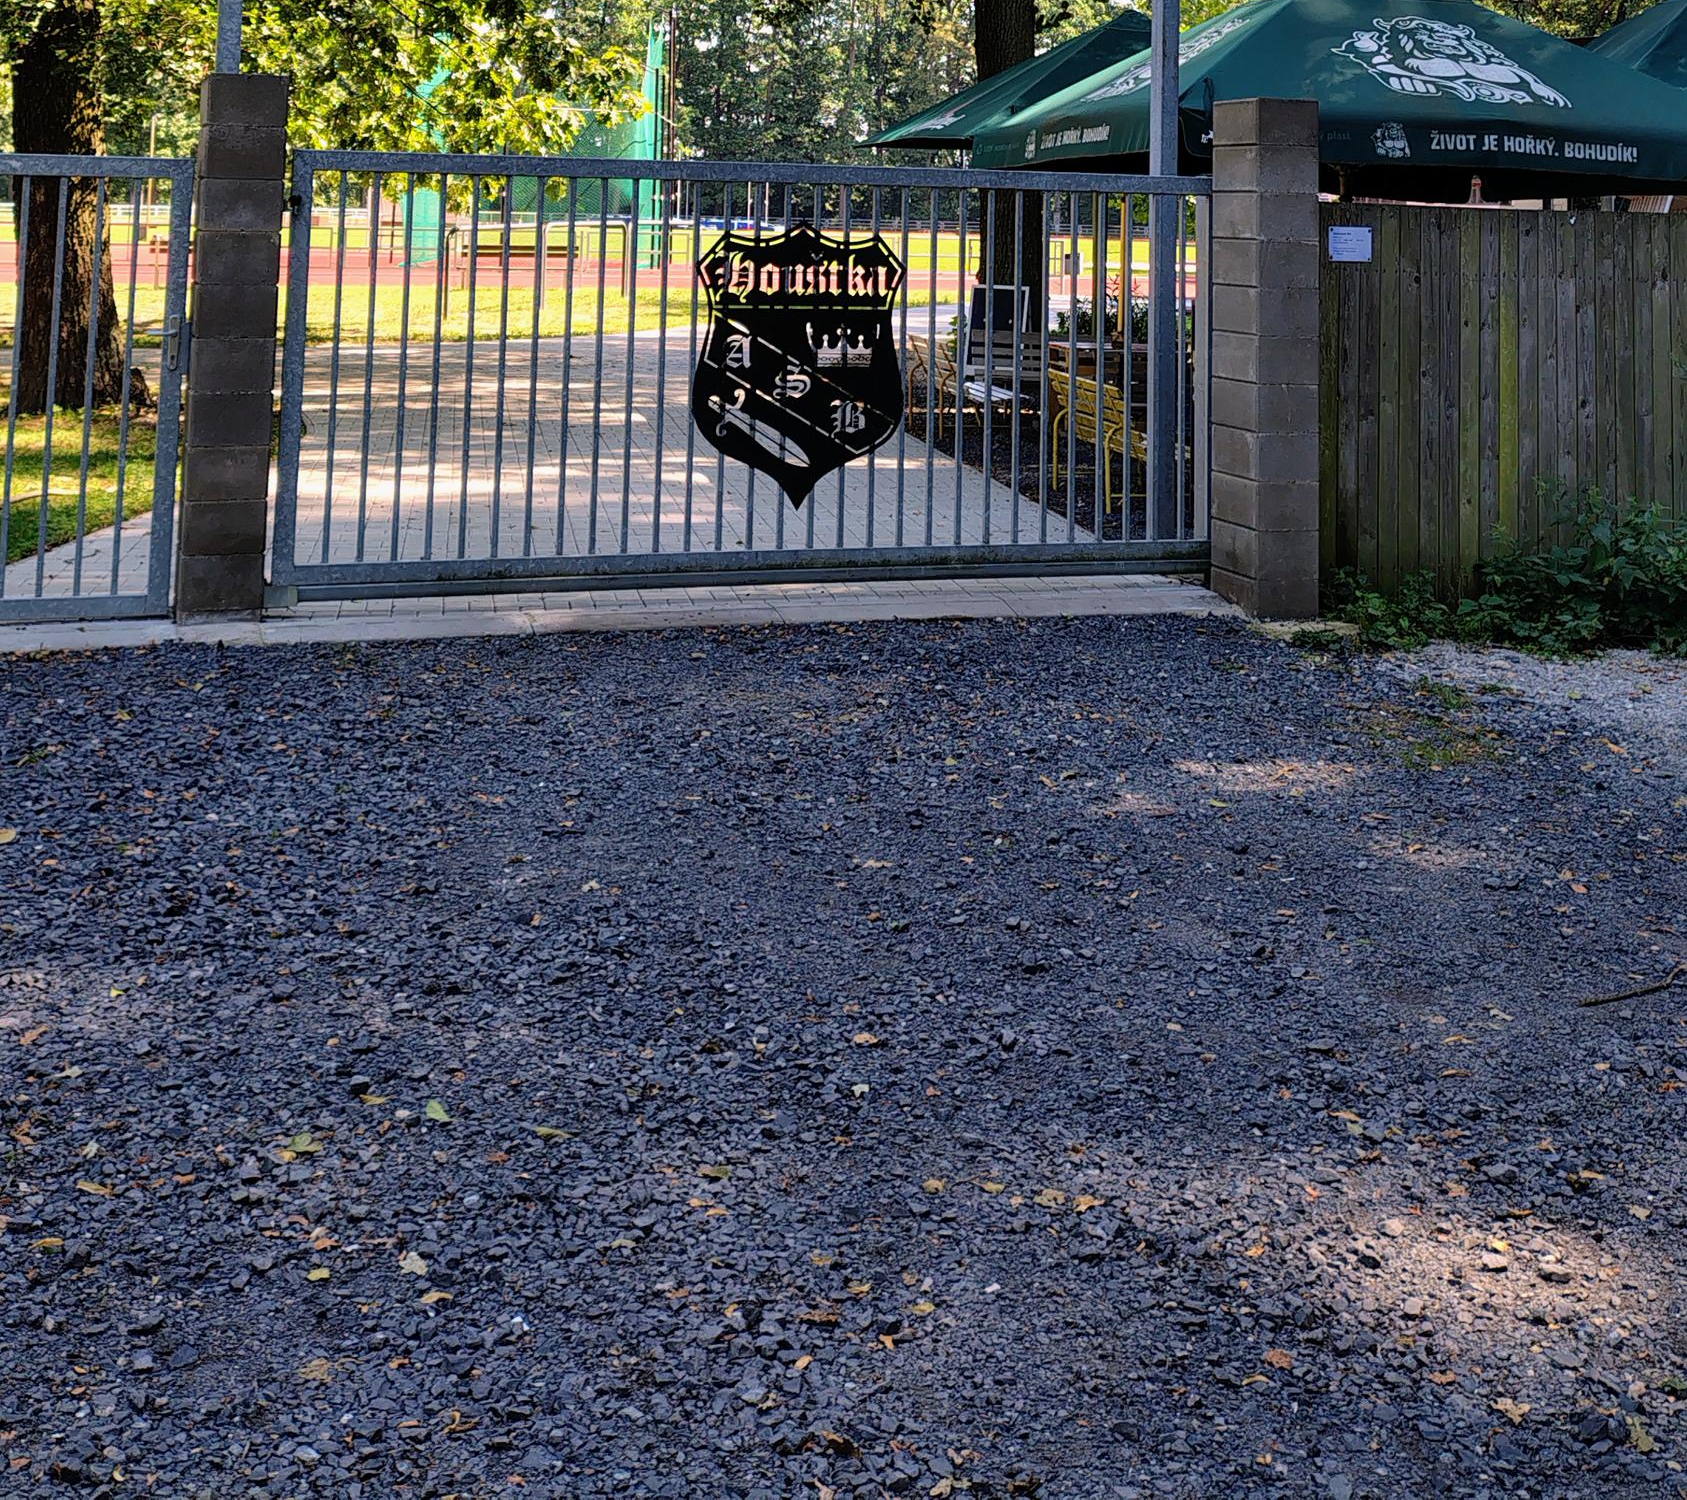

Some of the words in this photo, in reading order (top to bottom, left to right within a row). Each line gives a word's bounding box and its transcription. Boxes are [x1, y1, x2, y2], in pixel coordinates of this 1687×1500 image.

[1431, 131, 1477, 150] ŽIVOT
[1482, 134, 1498, 150] JE
[1504, 135, 1559, 156] HOŘKÝ.
[1564, 142, 1638, 162] BOHUDÍK!
[714, 250, 890, 303] Houštka
